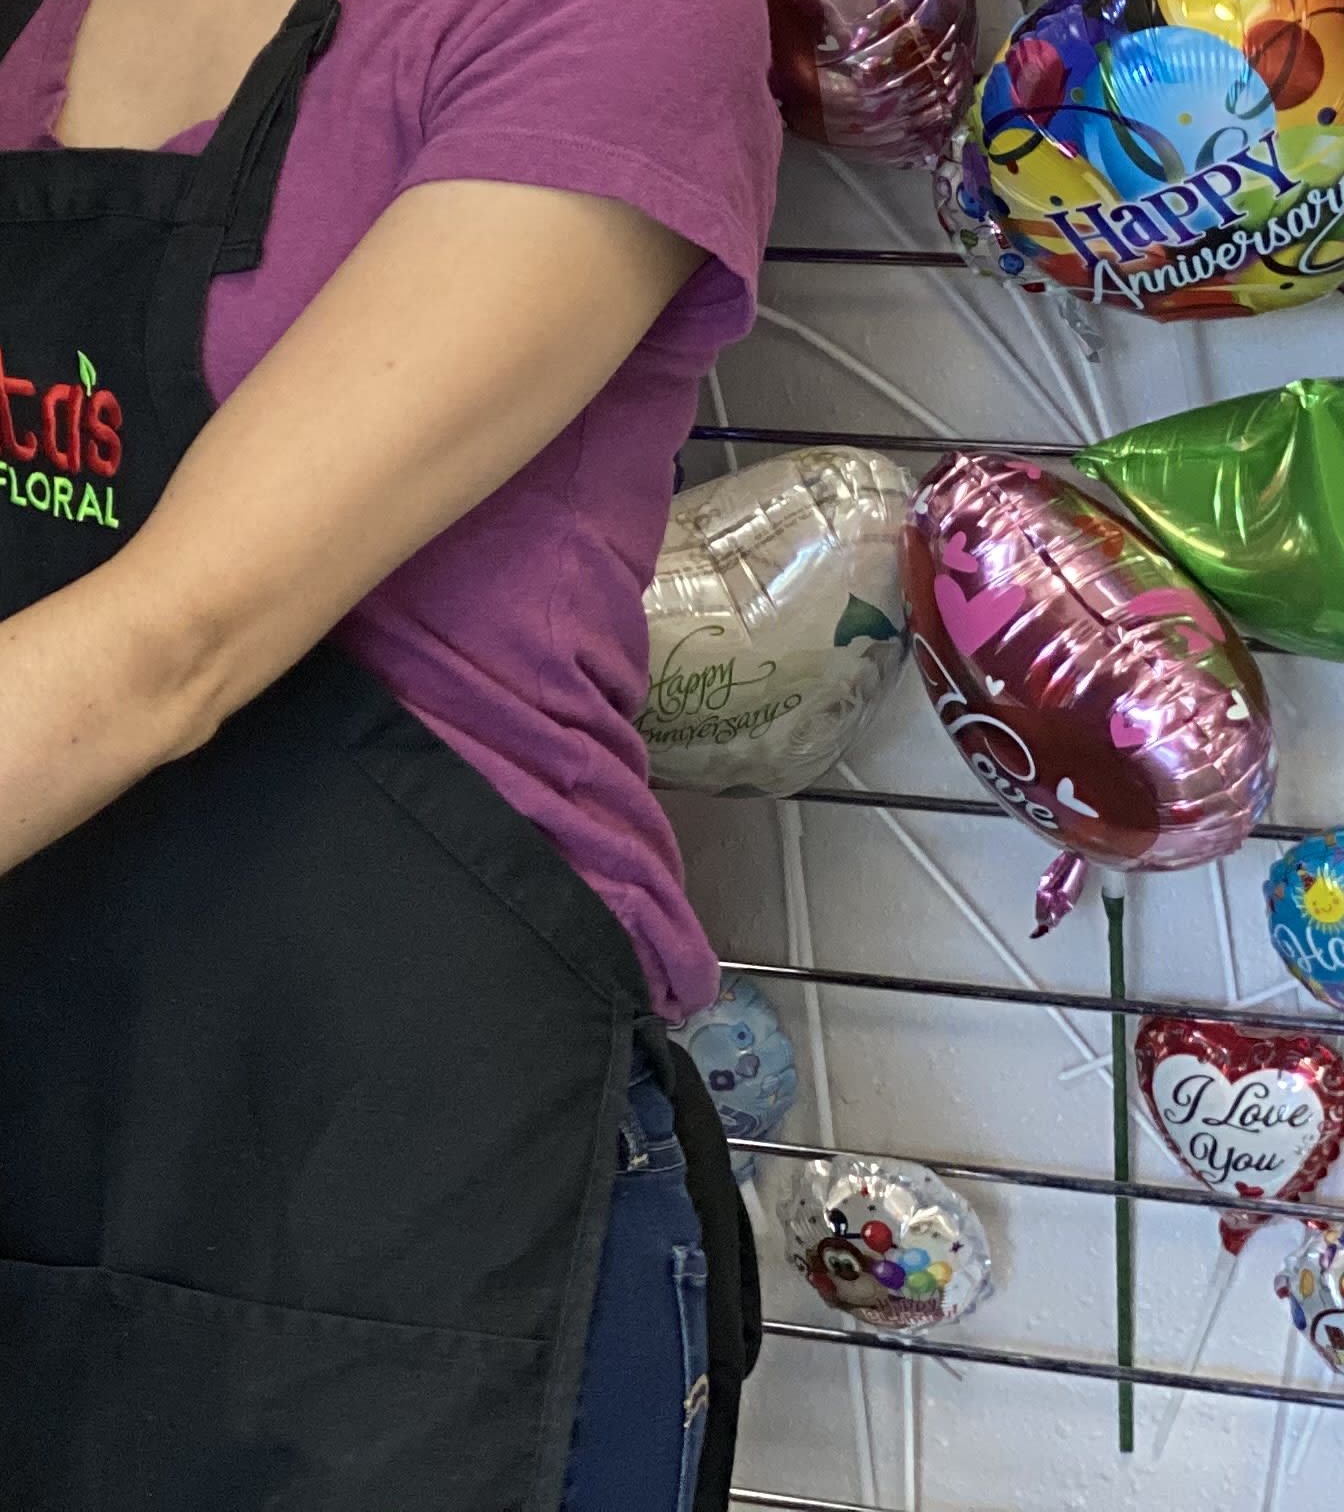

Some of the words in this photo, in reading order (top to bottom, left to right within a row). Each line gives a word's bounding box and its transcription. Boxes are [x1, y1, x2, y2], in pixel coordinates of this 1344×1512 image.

[1164, 1074, 1214, 1125] I
[1202, 1081, 1311, 1133] Love
[1189, 1131, 1286, 1184] You
